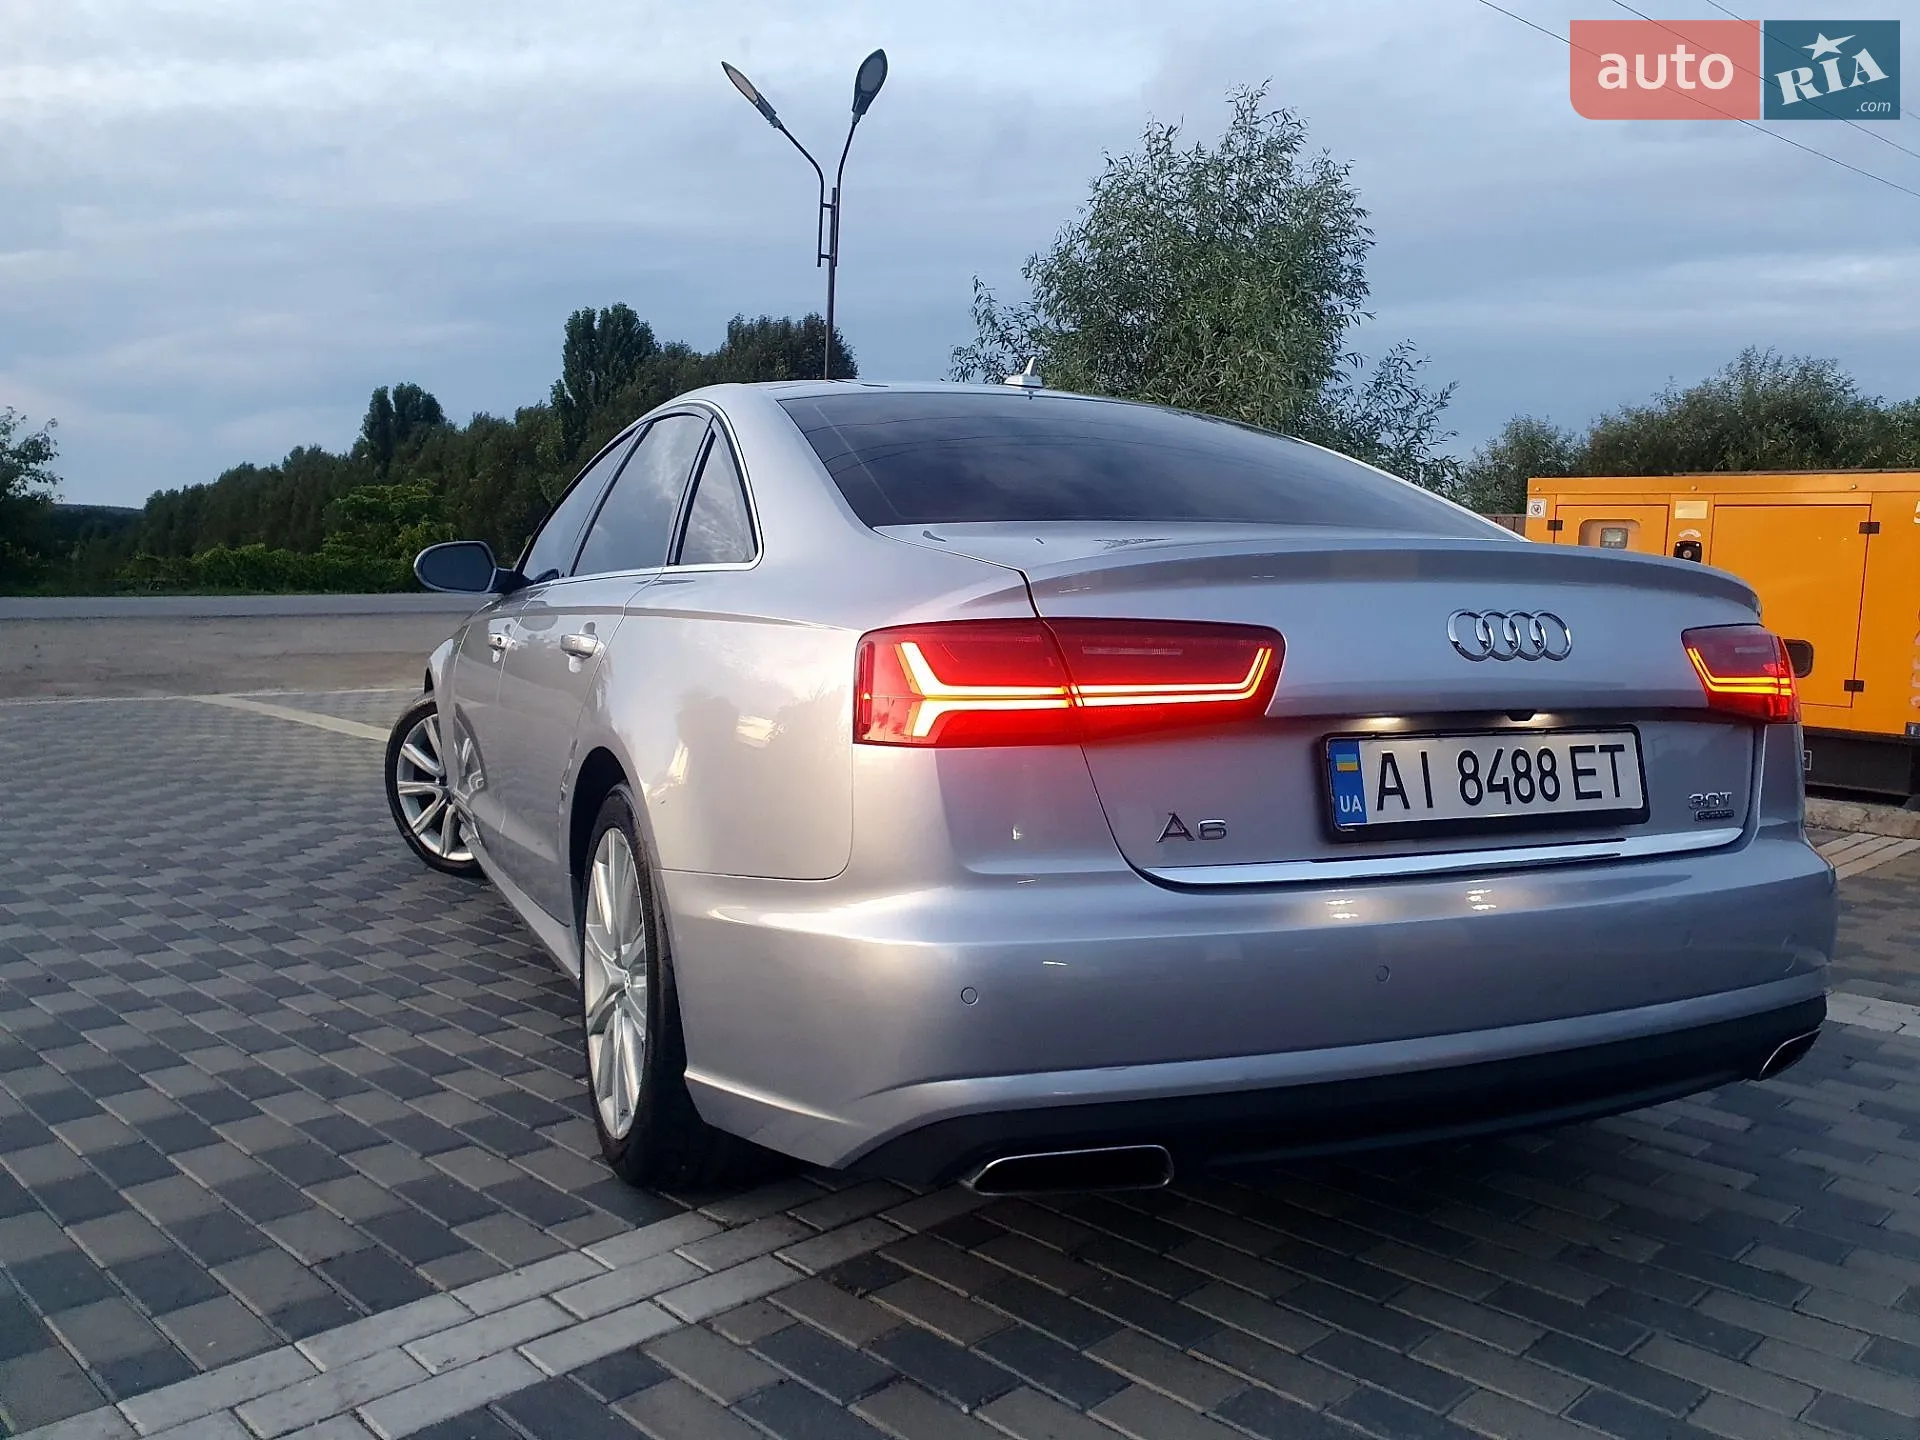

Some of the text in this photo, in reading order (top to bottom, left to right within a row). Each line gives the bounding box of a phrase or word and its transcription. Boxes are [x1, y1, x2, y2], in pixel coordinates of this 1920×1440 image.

[1376, 743, 1626, 811] AI 8488 ET
[1340, 795, 1363, 813] UA
[1156, 812, 1227, 843] A6
